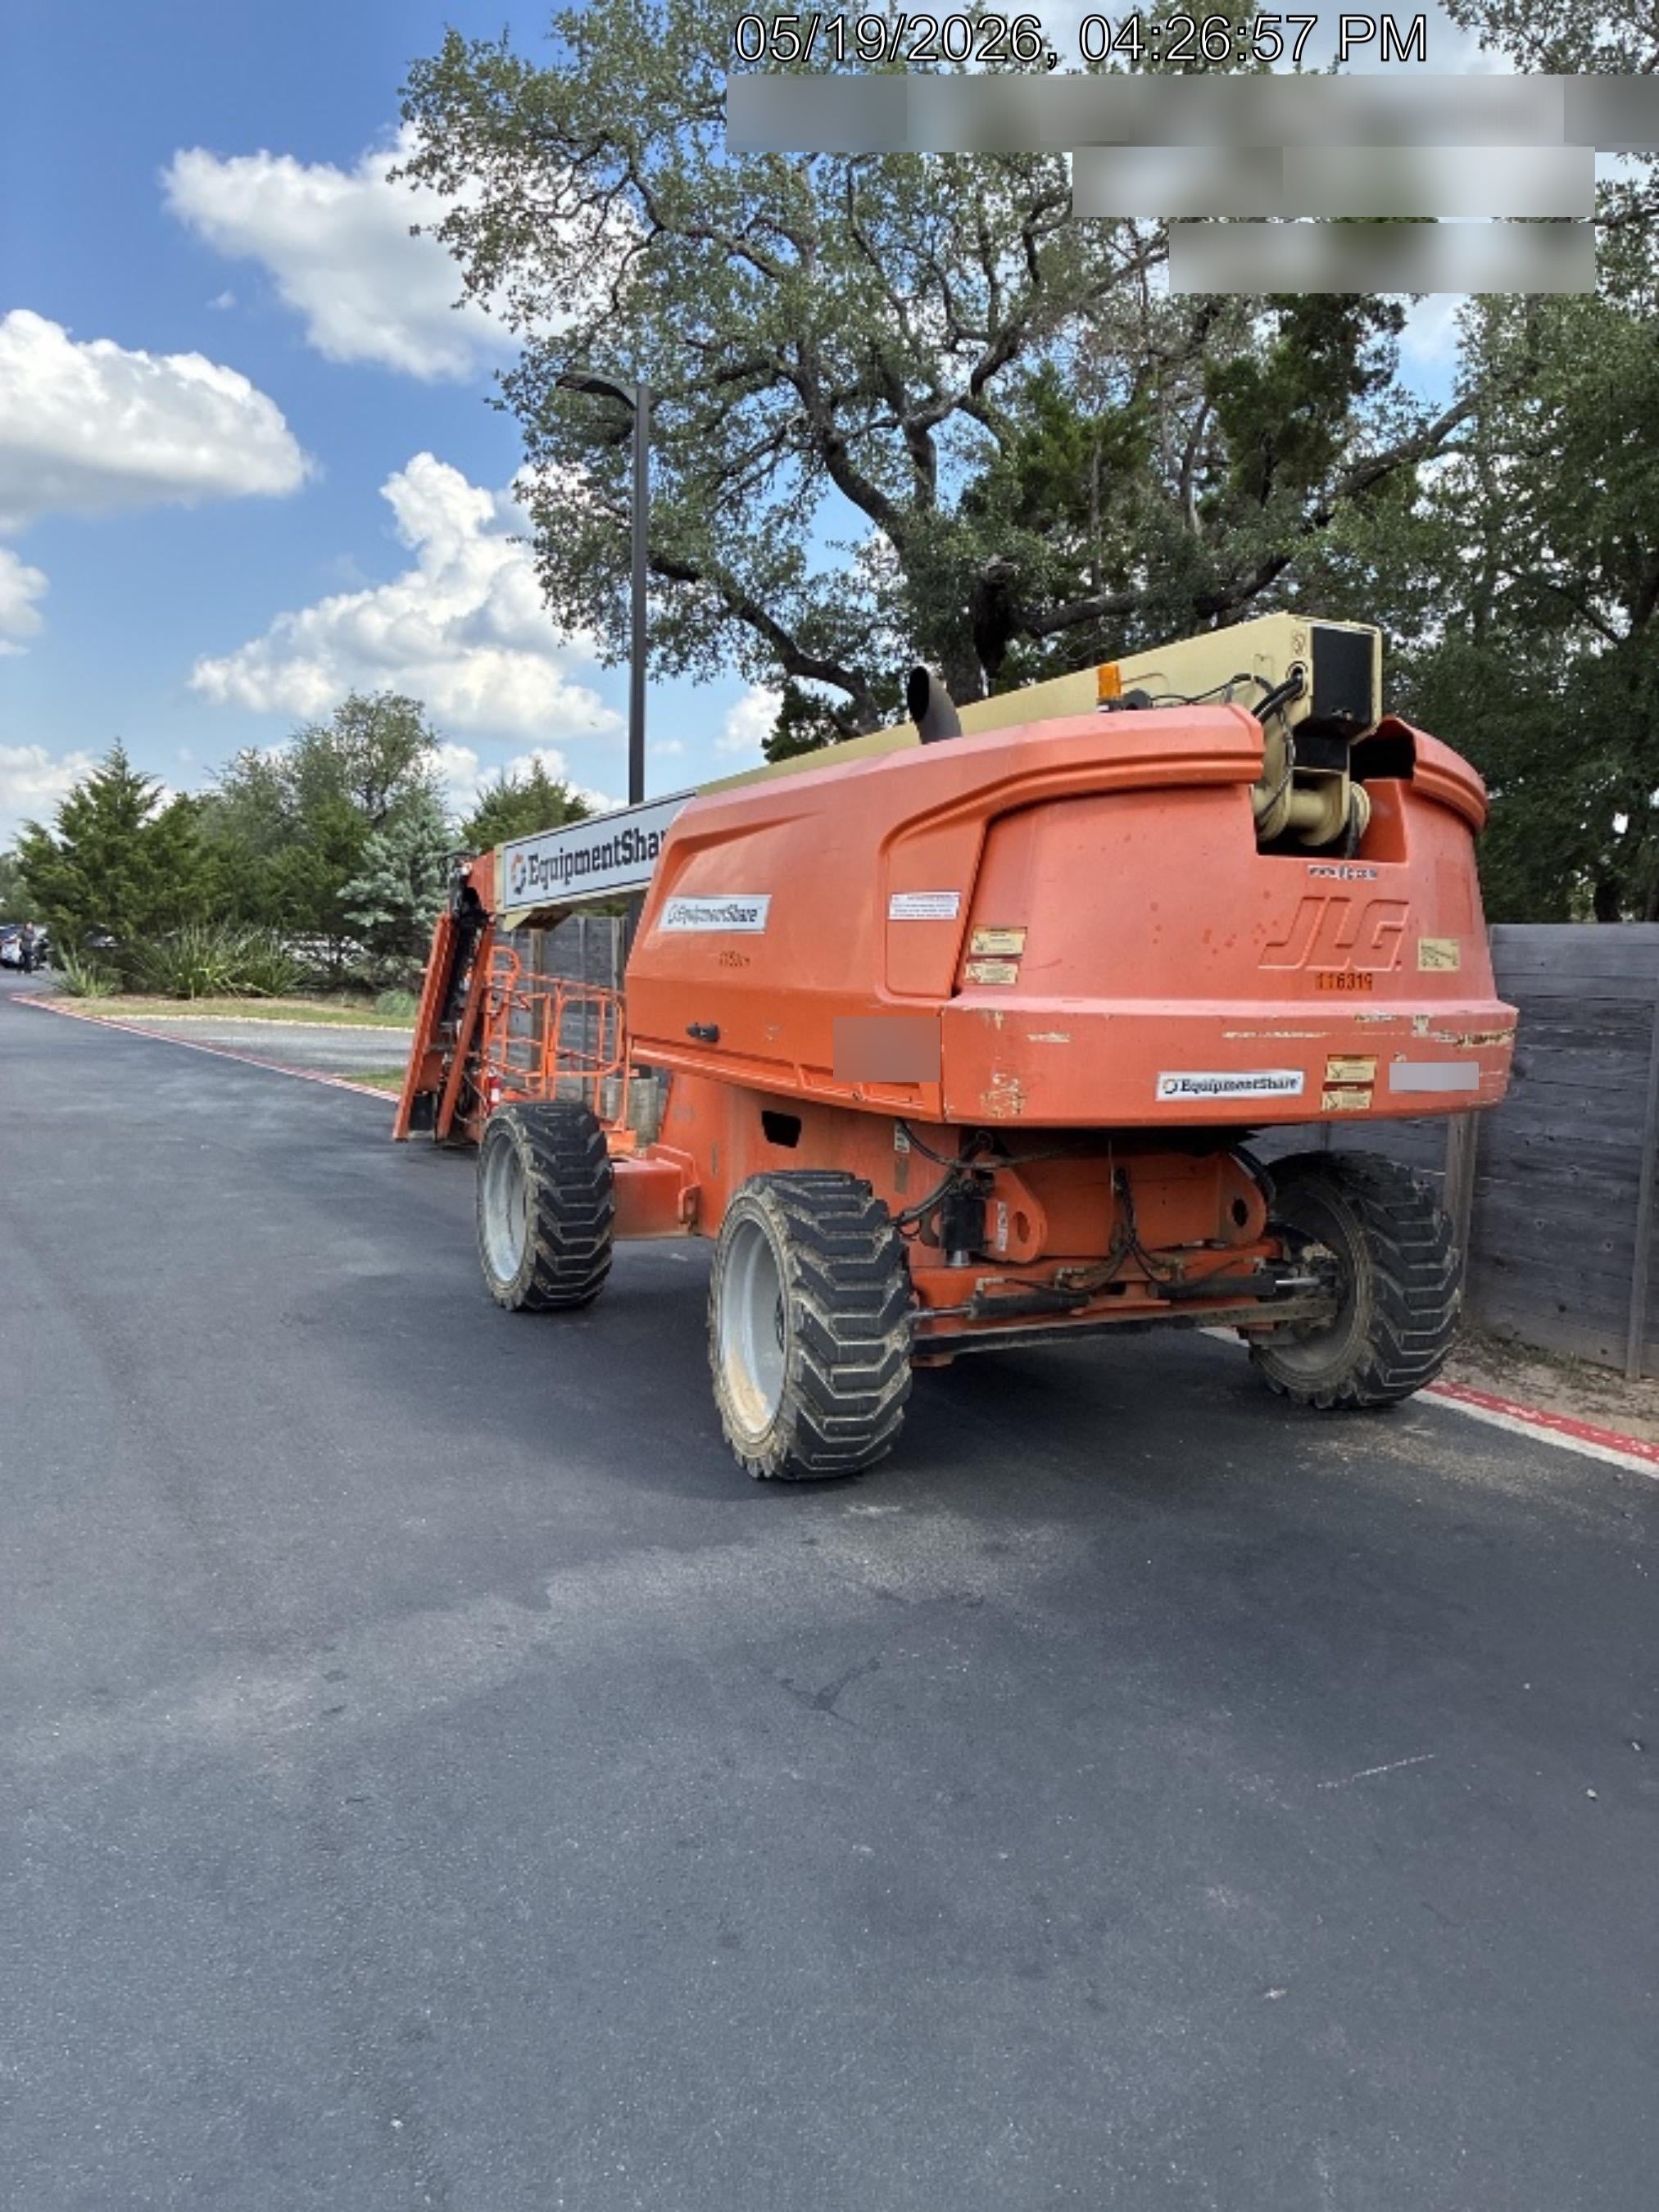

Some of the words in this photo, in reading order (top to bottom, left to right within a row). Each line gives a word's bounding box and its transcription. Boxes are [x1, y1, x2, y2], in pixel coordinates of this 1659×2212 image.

[528, 827, 667, 890] EquipmentSha
[1258, 896, 1409, 972] JLG
[1317, 972, 1372, 990] 116319
[1181, 1075, 1297, 1095] EquipmentShare
